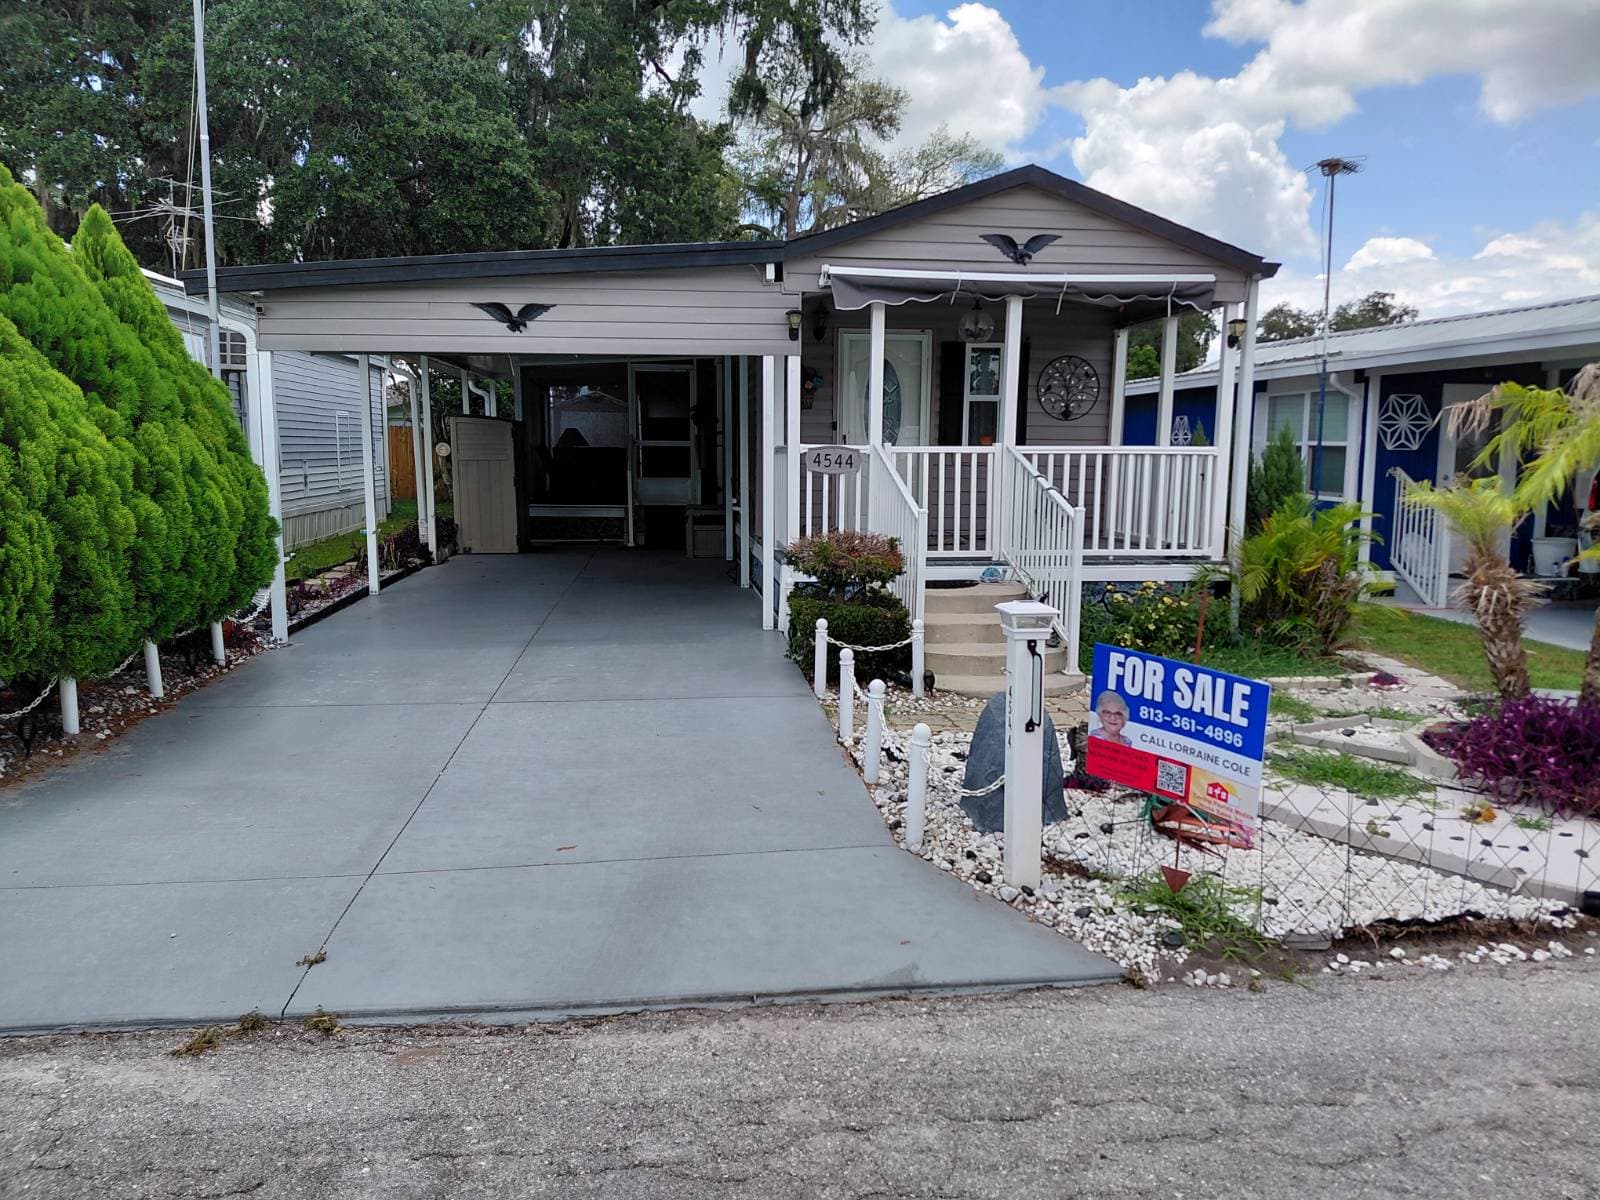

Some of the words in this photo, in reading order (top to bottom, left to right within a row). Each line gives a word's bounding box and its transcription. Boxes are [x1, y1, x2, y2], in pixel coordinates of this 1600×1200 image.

[813, 453, 854, 468] 4544
[1107, 652, 1165, 703] FOR
[1173, 668, 1251, 727] SALE
[1139, 706, 1243, 747] 813-361-4896
[1140, 733, 1167, 748] CALL
[1169, 740, 1220, 767] LORRAINE
[1222, 759, 1250, 777] COLE
